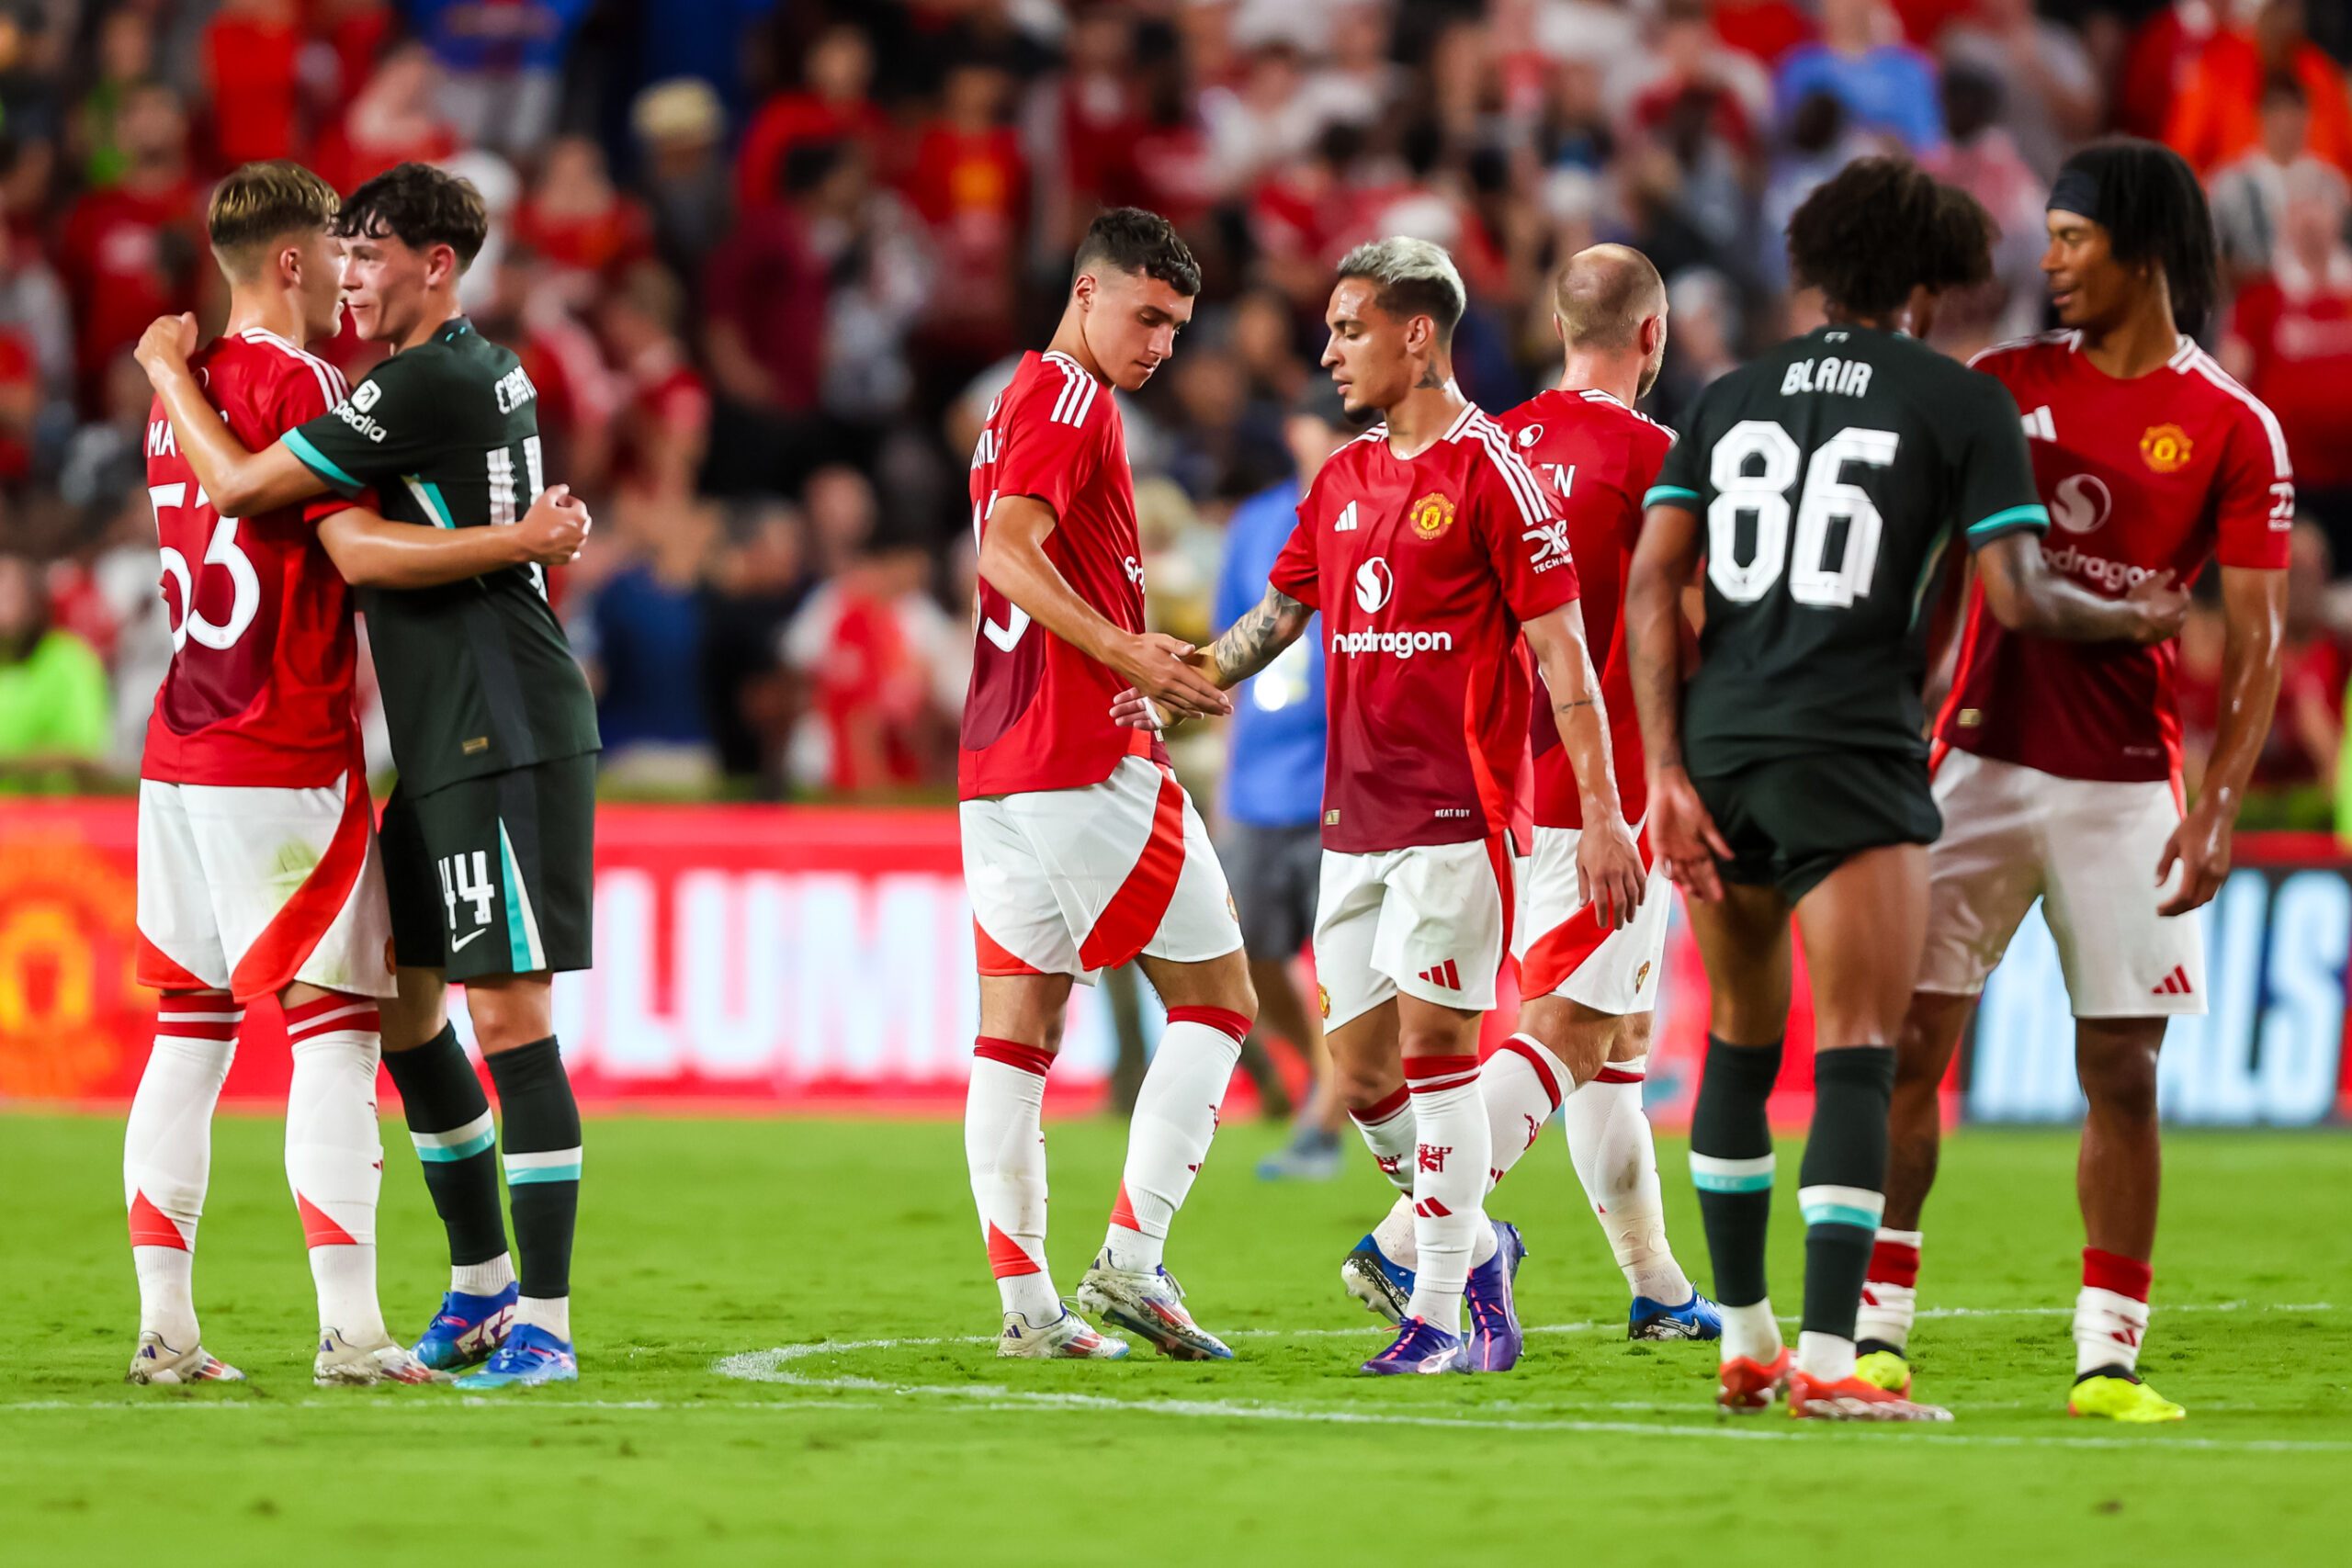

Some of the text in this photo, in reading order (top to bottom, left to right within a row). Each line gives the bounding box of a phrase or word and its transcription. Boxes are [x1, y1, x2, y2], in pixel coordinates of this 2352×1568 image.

[1780, 356, 1873, 399] BLAIR
[148, 482, 260, 653] 53
[1707, 420, 1900, 609] 86
[438, 851, 495, 931] 44
